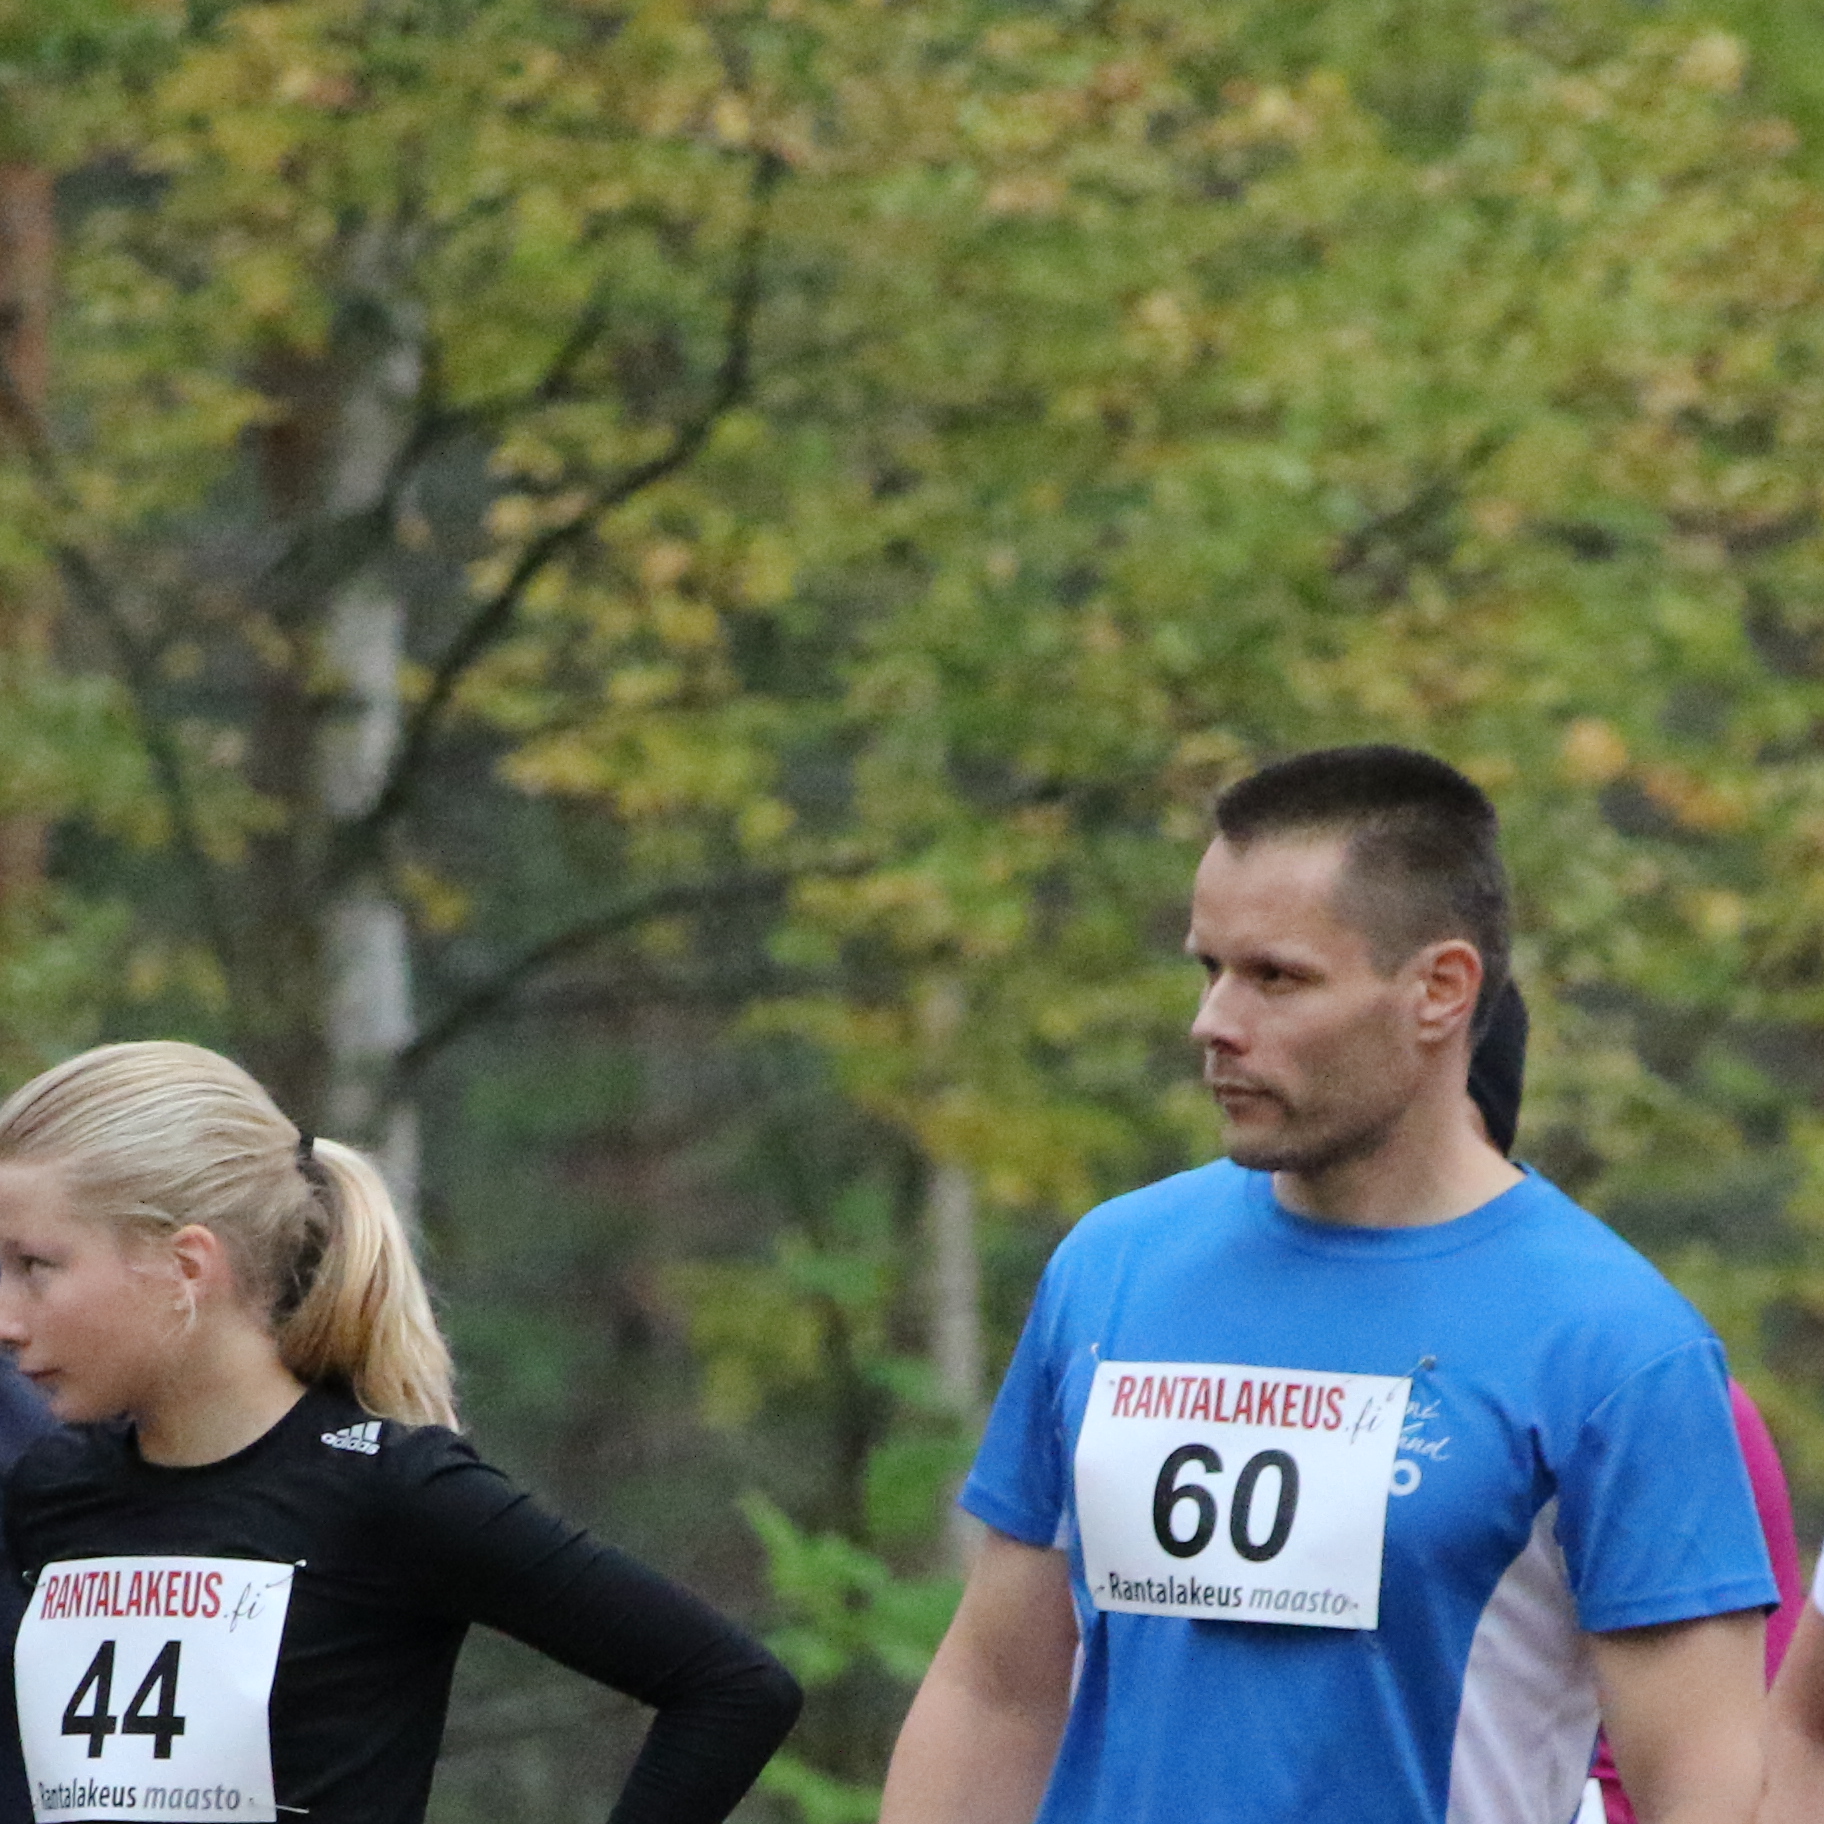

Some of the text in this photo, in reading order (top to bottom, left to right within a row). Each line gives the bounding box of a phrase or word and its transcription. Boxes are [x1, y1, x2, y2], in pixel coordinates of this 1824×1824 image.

[320, 1431, 381, 1456] adidas
[1152, 1443, 1300, 1562] 60
[1108, 1572, 1350, 1616] Rantalakeus maasto
[61, 1639, 186, 1760] 44
[143, 1784, 241, 1811] maasto
